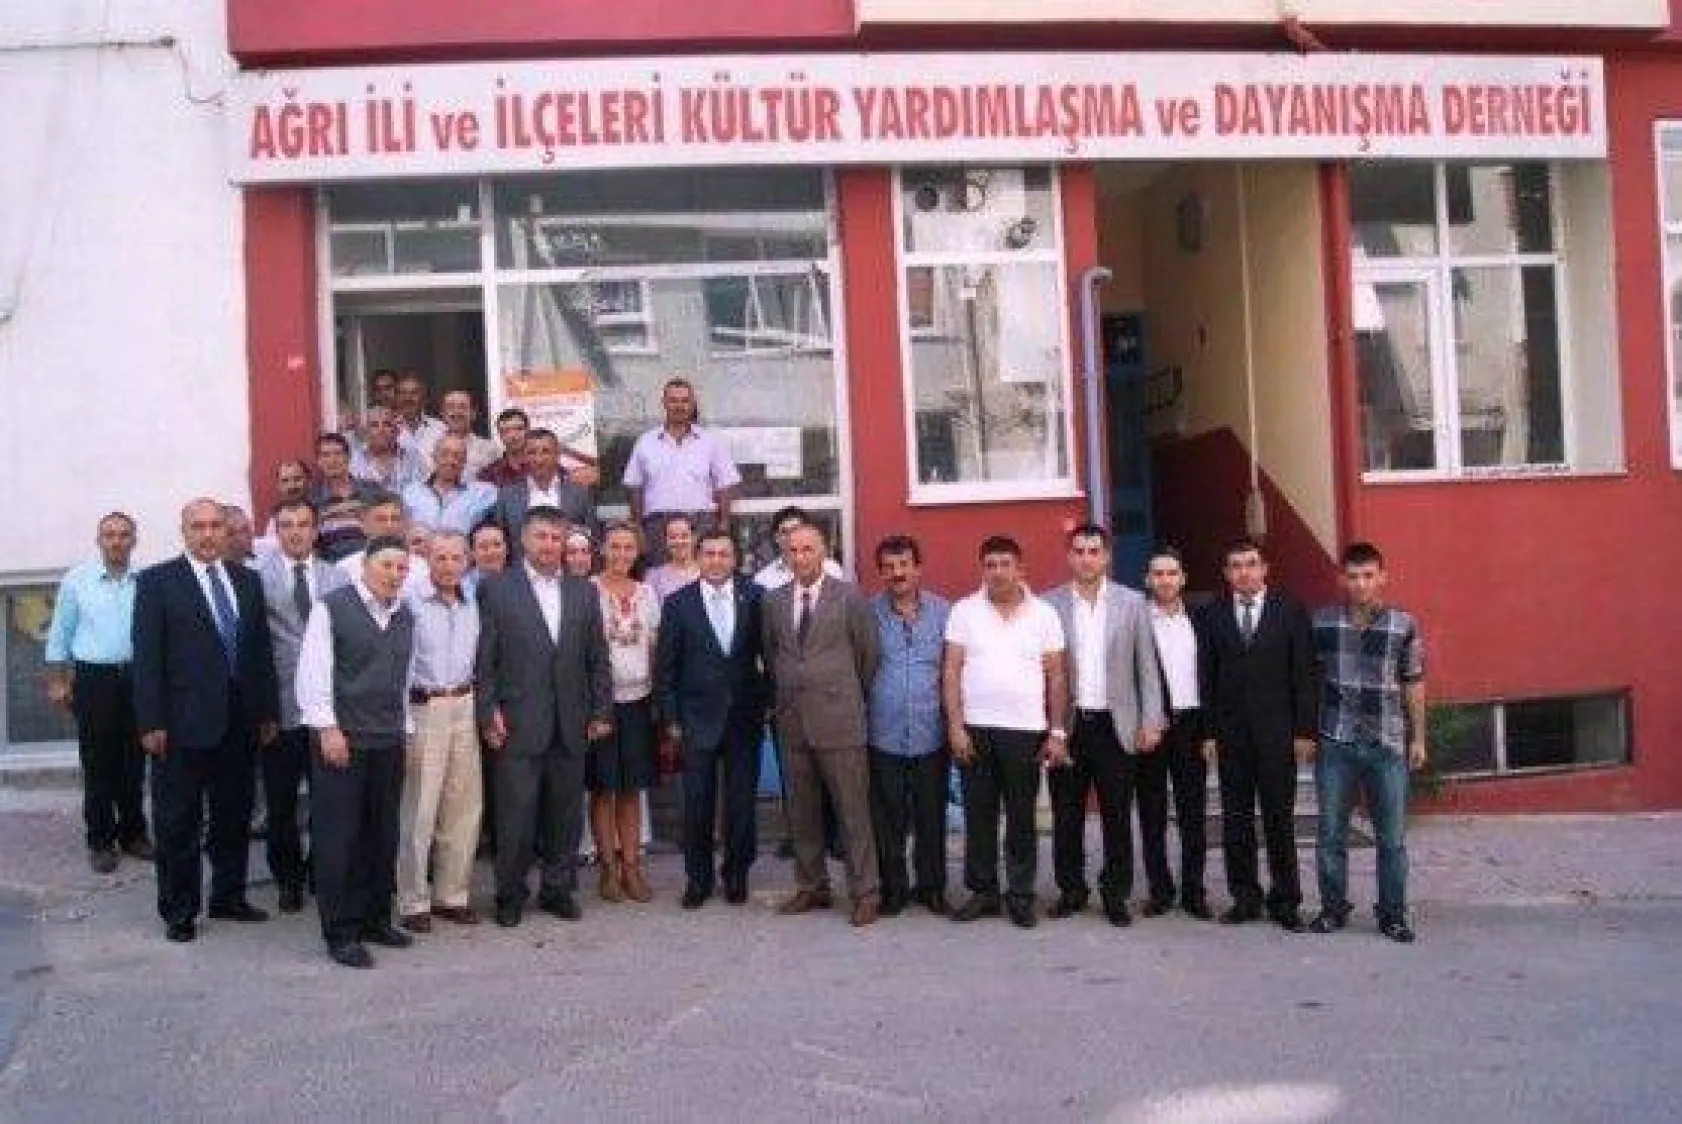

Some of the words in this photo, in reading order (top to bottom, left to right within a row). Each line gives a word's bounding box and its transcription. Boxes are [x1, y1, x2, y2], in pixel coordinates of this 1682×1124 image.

[250, 87, 349, 158] AĞRI
[366, 82, 416, 153] İLİ
[429, 110, 480, 151] ve
[496, 72, 665, 164] İLÇELERİ
[679, 72, 842, 143] KÜLTÜR
[853, 84, 1145, 153] YARDIMLAŞMA
[1155, 96, 1200, 136] ve
[1213, 82, 1430, 152] DAYANIŞMA
[1442, 66, 1590, 135] DERNEĞİ
